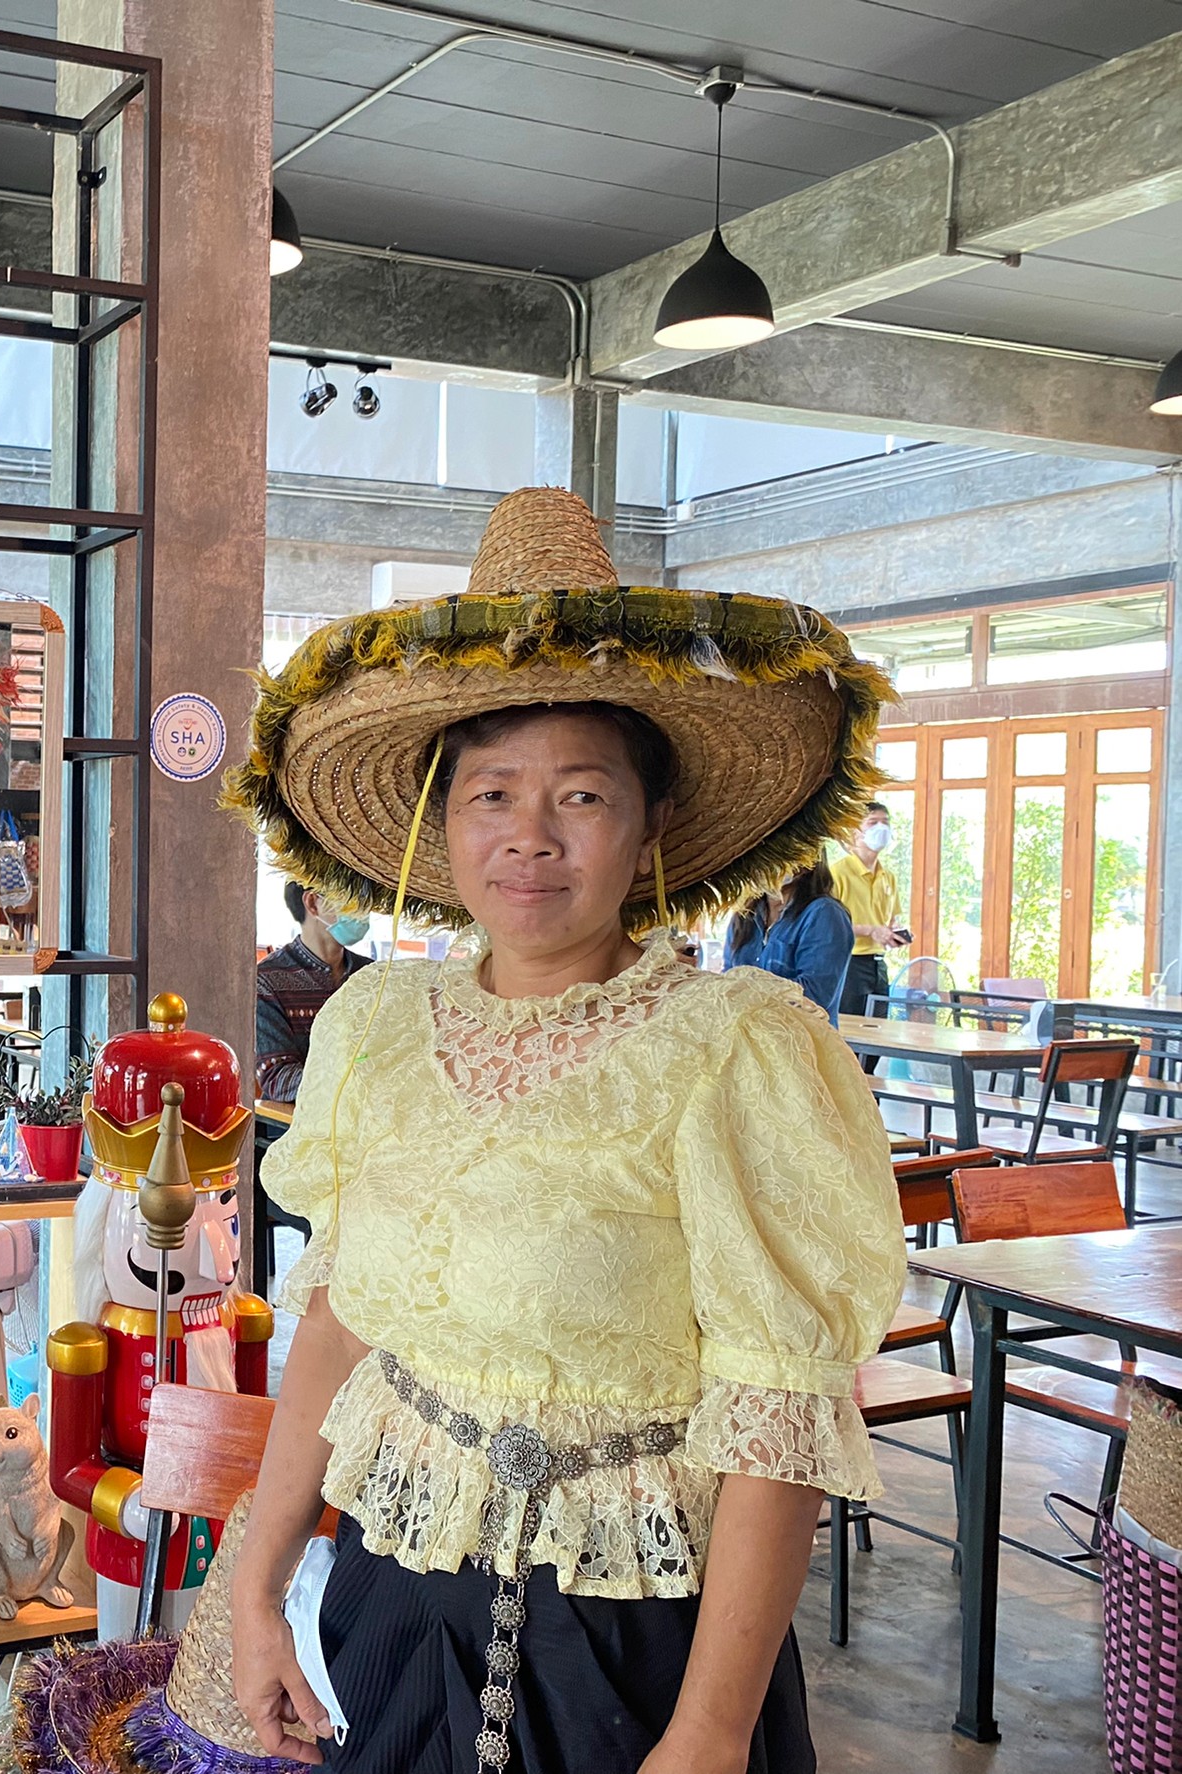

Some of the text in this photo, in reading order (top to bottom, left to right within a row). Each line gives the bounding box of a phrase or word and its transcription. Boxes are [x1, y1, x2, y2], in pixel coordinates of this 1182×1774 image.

[157, 711, 172, 737] Thailand
[172, 703, 190, 712] Safety
[197, 705, 213, 721] Health
[170, 731, 205, 744] SHA
